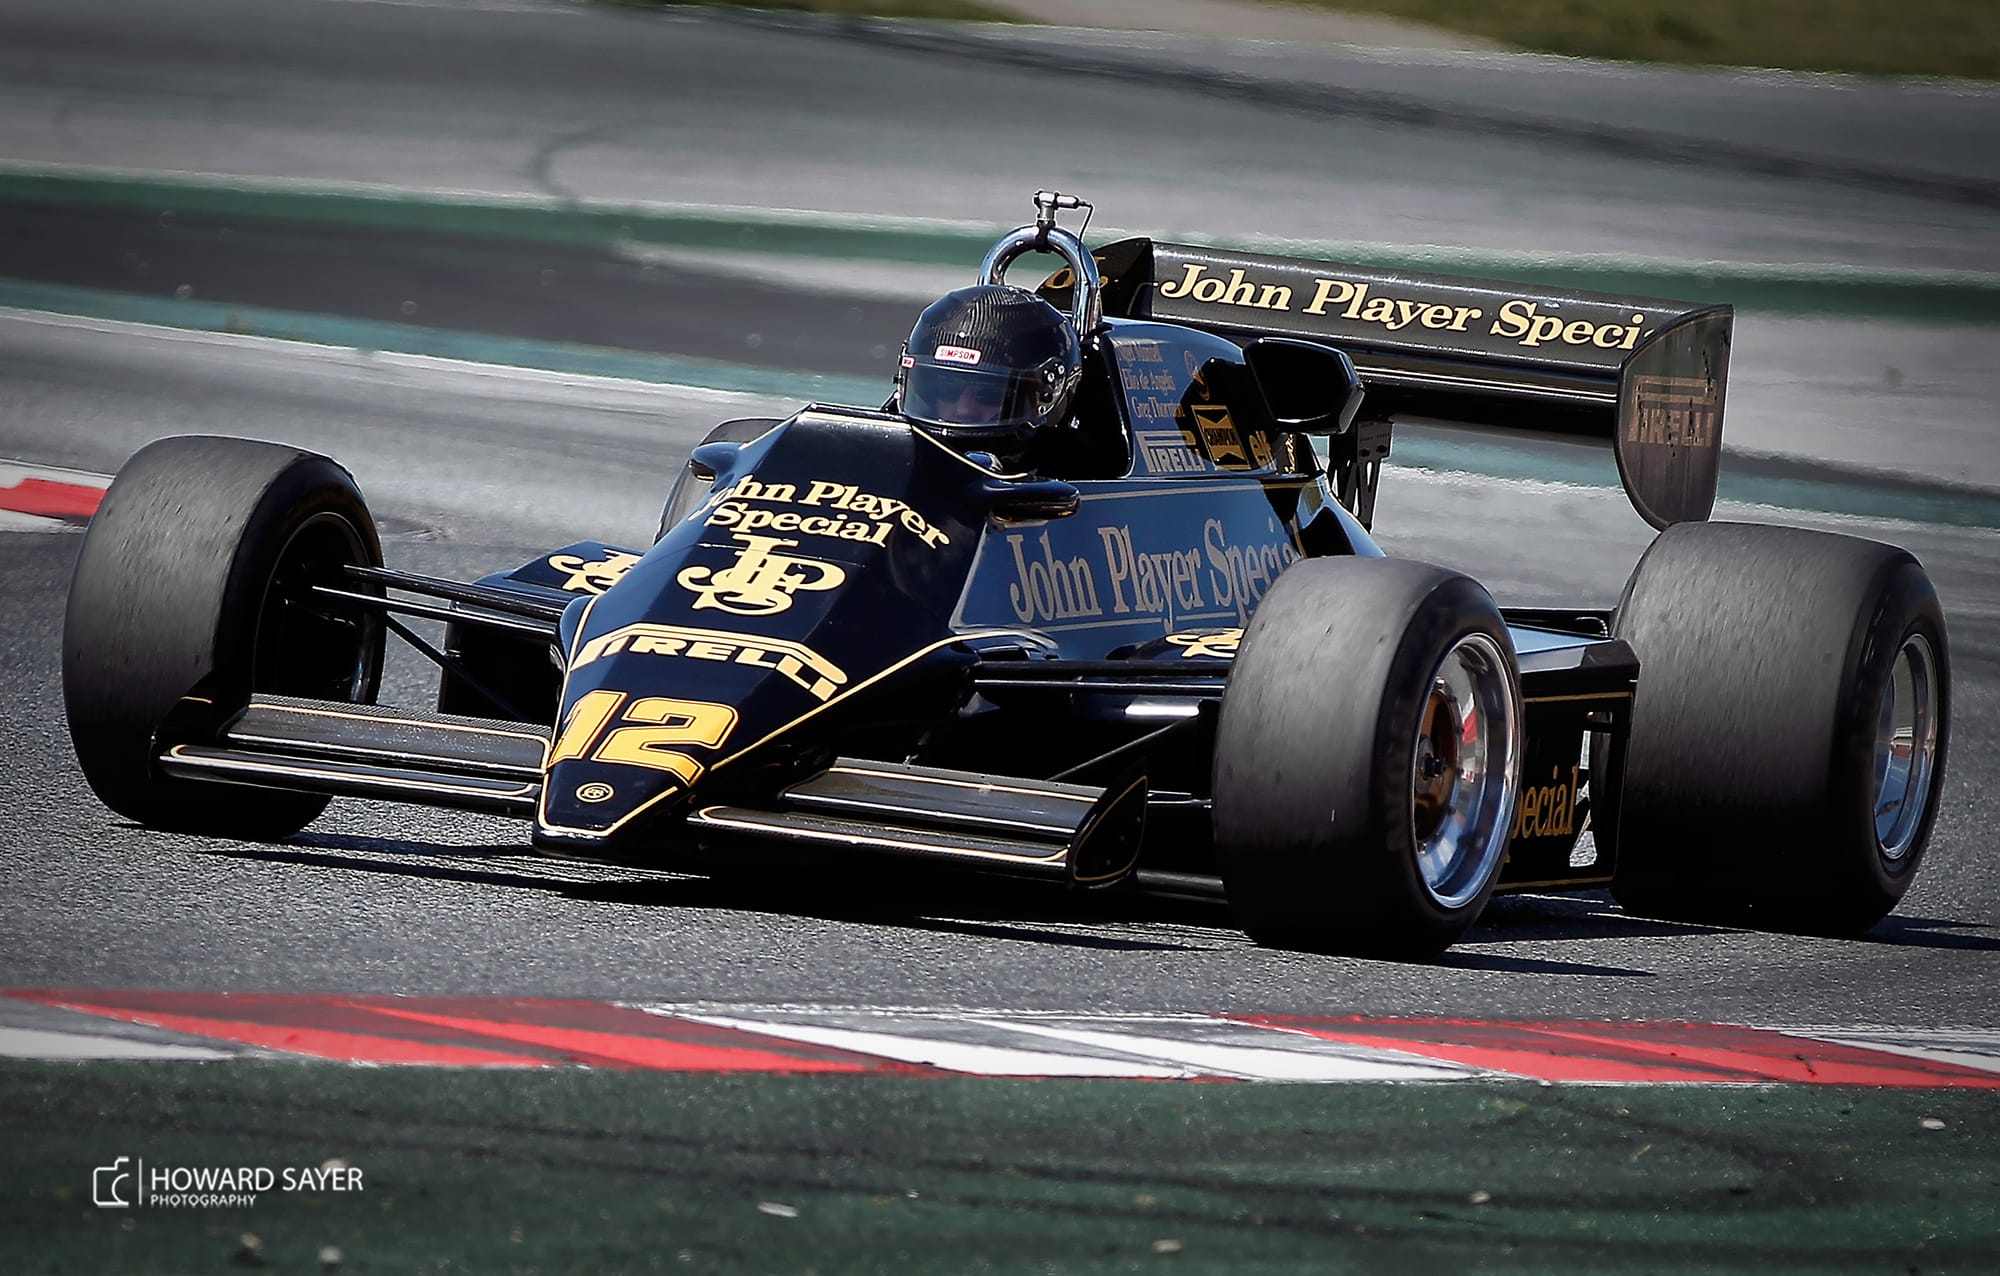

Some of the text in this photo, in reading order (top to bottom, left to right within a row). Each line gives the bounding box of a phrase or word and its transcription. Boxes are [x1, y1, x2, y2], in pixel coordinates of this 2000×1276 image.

[1160, 263, 1293, 311] John
[1302, 278, 1482, 331] Player
[1489, 300, 1656, 350] Speci
[939, 347, 976, 361] SIMPSON
[1628, 375, 1717, 447] PIRELLI
[1135, 430, 1206, 473] PIRELLI
[1249, 430, 1277, 471] elf
[703, 501, 893, 548] Special
[797, 480, 950, 549] Player
[1007, 529, 1102, 624] John
[1097, 524, 1205, 633] Player
[570, 622, 848, 702] PIRELLI
[547, 690, 739, 788] 12
[1512, 762, 1580, 839] ecial
